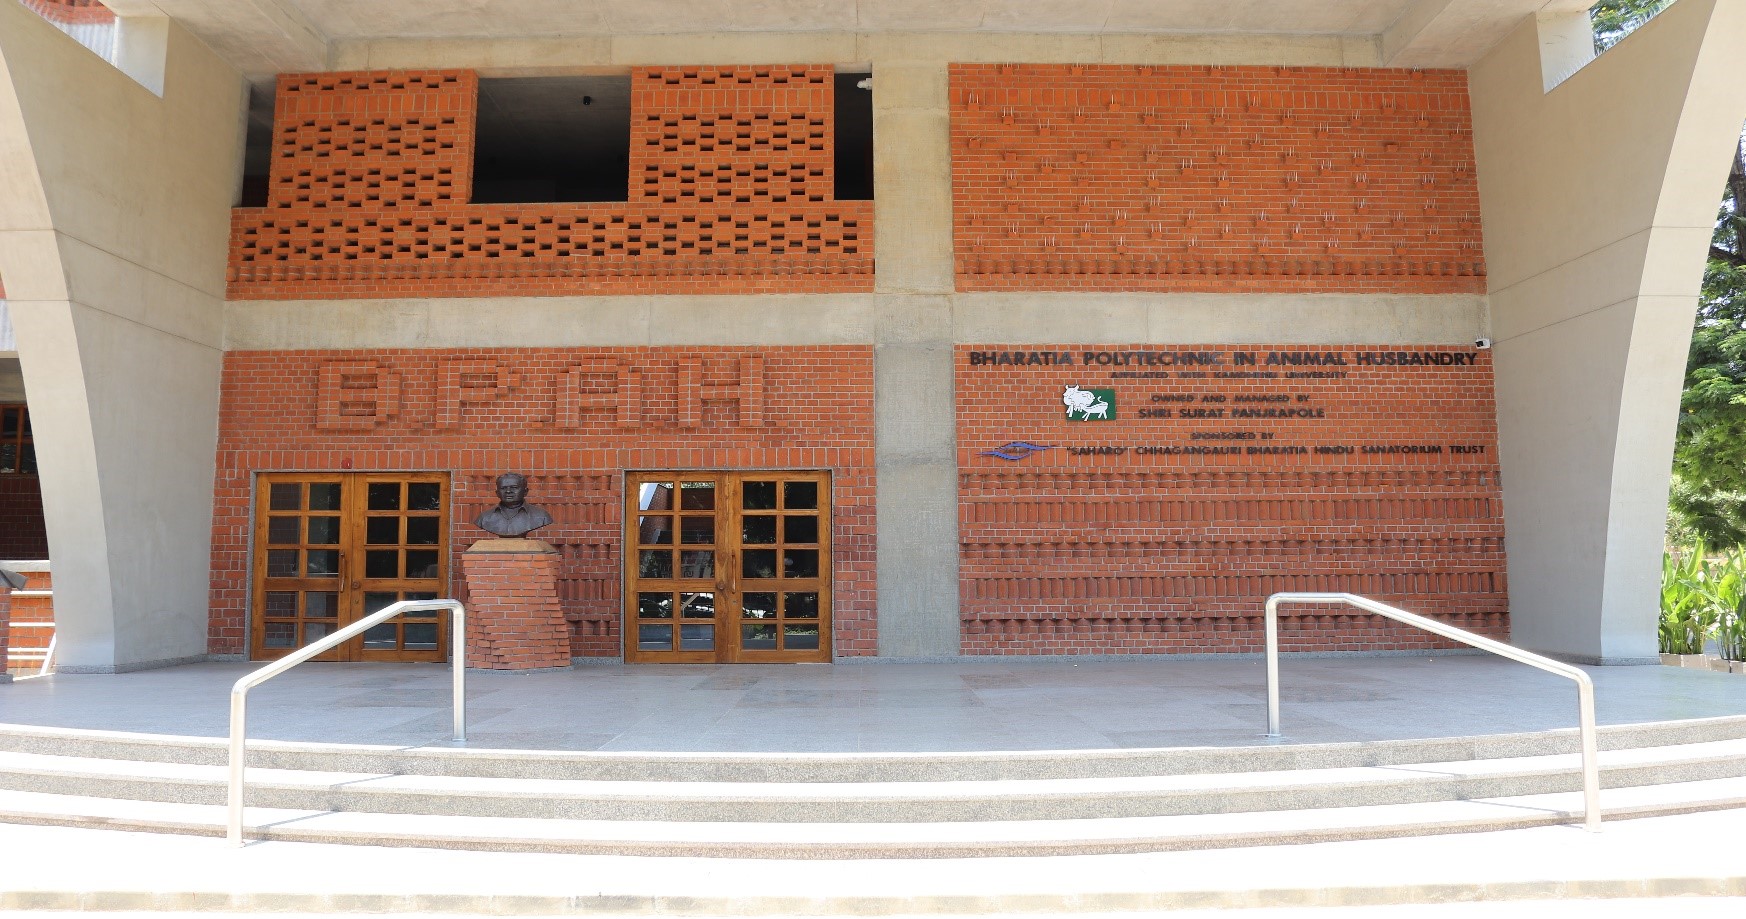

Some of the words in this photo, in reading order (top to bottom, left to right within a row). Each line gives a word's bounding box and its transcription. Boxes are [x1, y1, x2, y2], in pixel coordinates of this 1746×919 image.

[970, 351, 1073, 366] BHARATIA
[1083, 351, 1225, 366] POLYTECHNIC
[1233, 351, 1256, 366] IN
[1266, 351, 1348, 366] ANIMAL
[1356, 351, 1478, 366] HUSBANDRY
[1285, 371, 1348, 379] UNIVERSITY
[1151, 394, 1195, 403] OWNED
[1201, 394, 1227, 403] AND
[1234, 394, 1290, 402] MANAGED
[1297, 394, 1310, 402] BY
[1139, 408, 1172, 418] SHRI
[1179, 408, 1225, 418] SURAT
[1231, 408, 1325, 418] PANJRAPOLE
[1191, 432, 1256, 440] SPONSORED
[1261, 432, 1275, 440] BY
[1135, 446, 1242, 455] CHHAGANGAURI
[1247, 446, 1308, 455] BHARATIA
[1314, 446, 1355, 455] HINDU
[1361, 445, 1443, 455] SANATORIUM
[1449, 445, 1486, 455] TRUST
